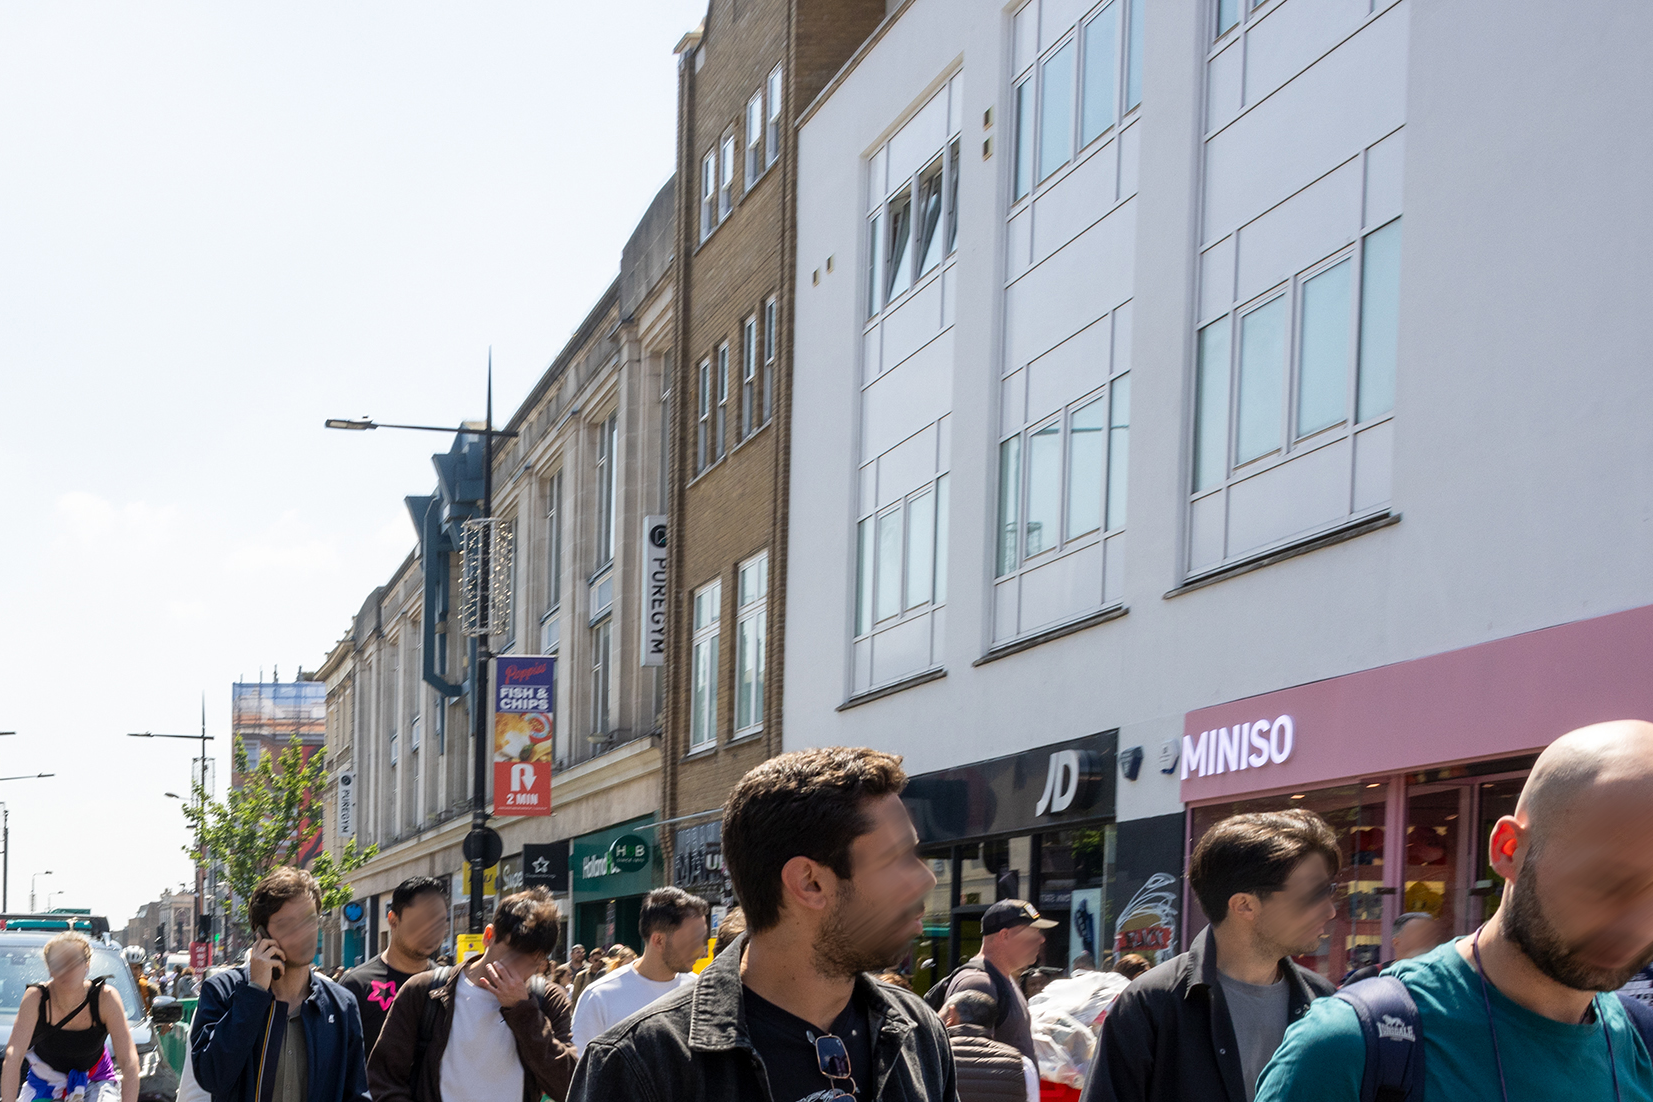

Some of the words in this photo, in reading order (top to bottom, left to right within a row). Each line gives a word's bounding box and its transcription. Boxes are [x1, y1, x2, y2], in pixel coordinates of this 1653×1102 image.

[500, 687, 534, 699] FISH
[536, 687, 548, 698] &
[500, 698, 548, 710] CHIPS
[1181, 714, 1293, 780] MINISO
[1036, 749, 1079, 817] JD
[506, 793, 514, 805] 2
[516, 793, 538, 805] MIN
